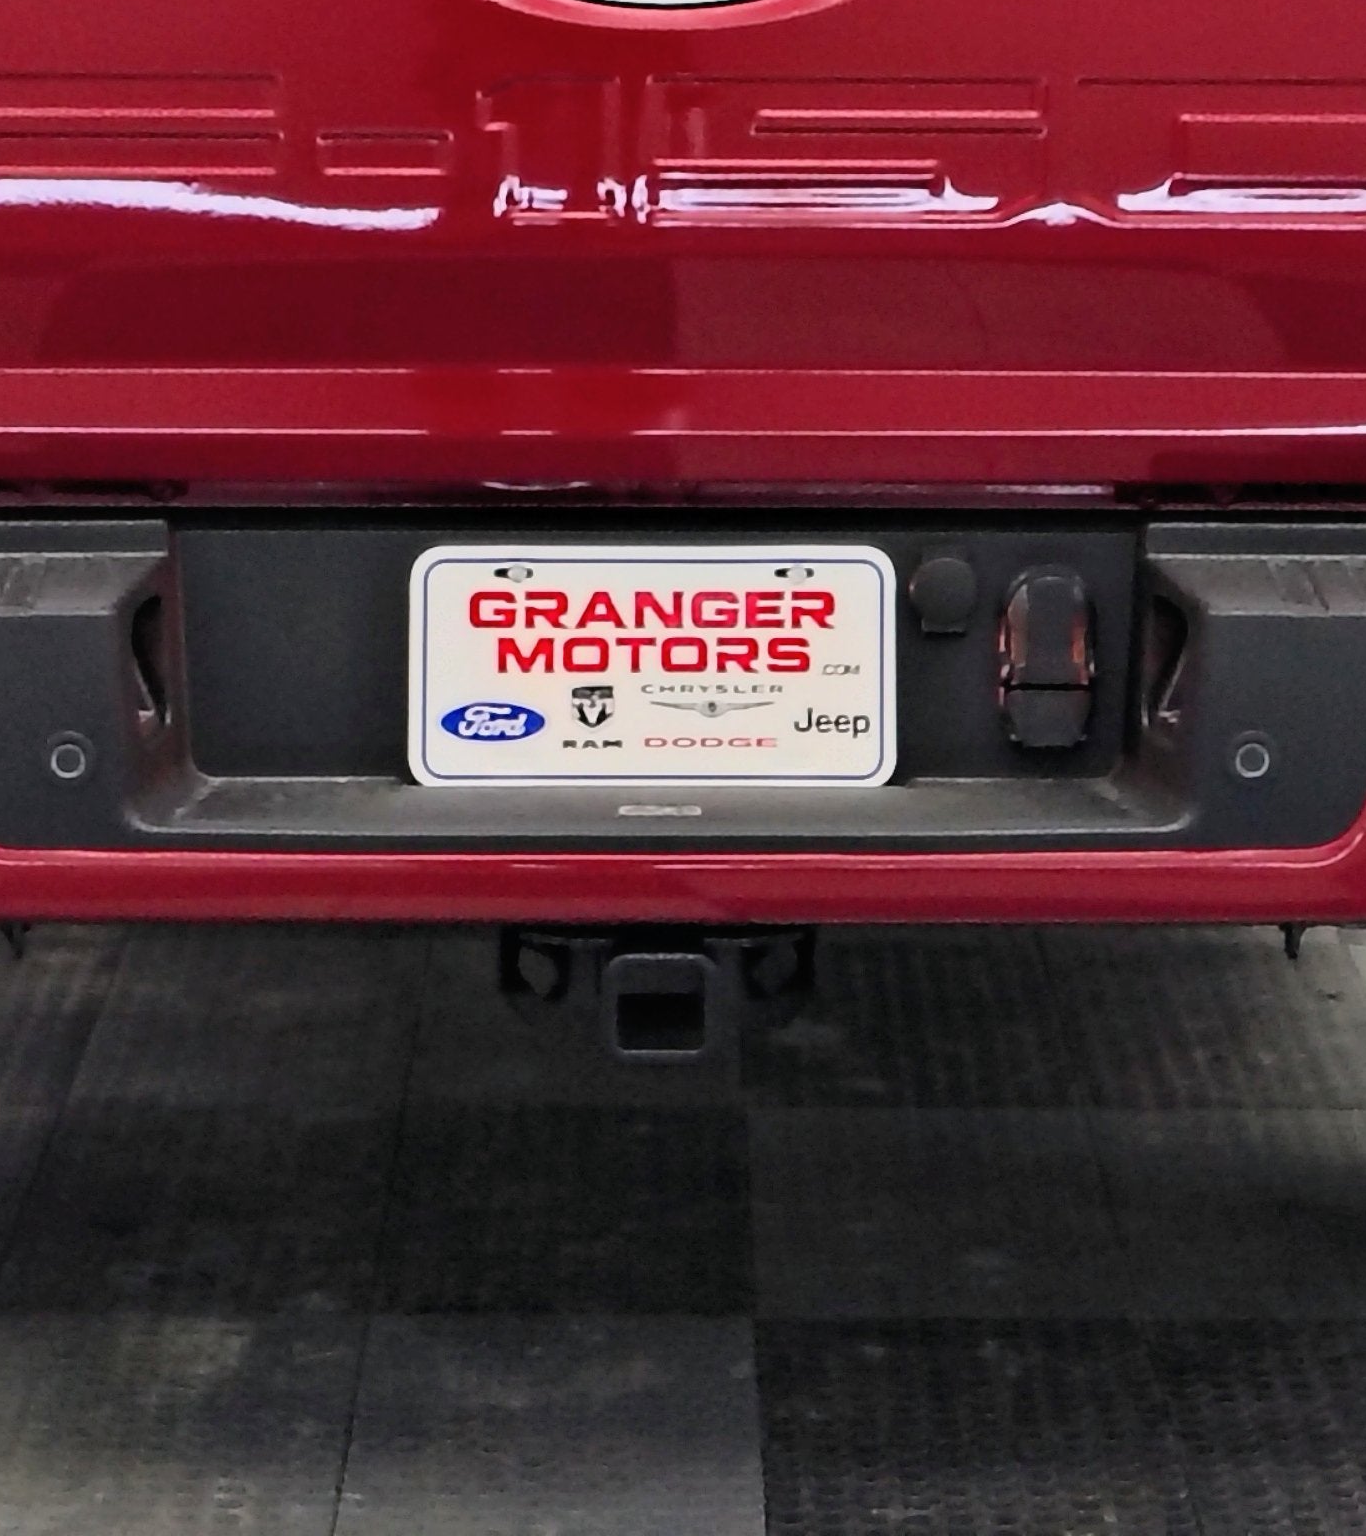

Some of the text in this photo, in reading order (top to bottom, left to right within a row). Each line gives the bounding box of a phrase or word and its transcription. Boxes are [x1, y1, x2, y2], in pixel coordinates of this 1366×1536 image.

[468, 590, 836, 630] GRANGER
[497, 636, 812, 675] MOTORS
[640, 684, 784, 695] CHRYSLER
[458, 705, 527, 737] Ford
[793, 707, 871, 739] Jeep
[562, 739, 624, 749] RAM
[643, 737, 779, 749] DODGE
